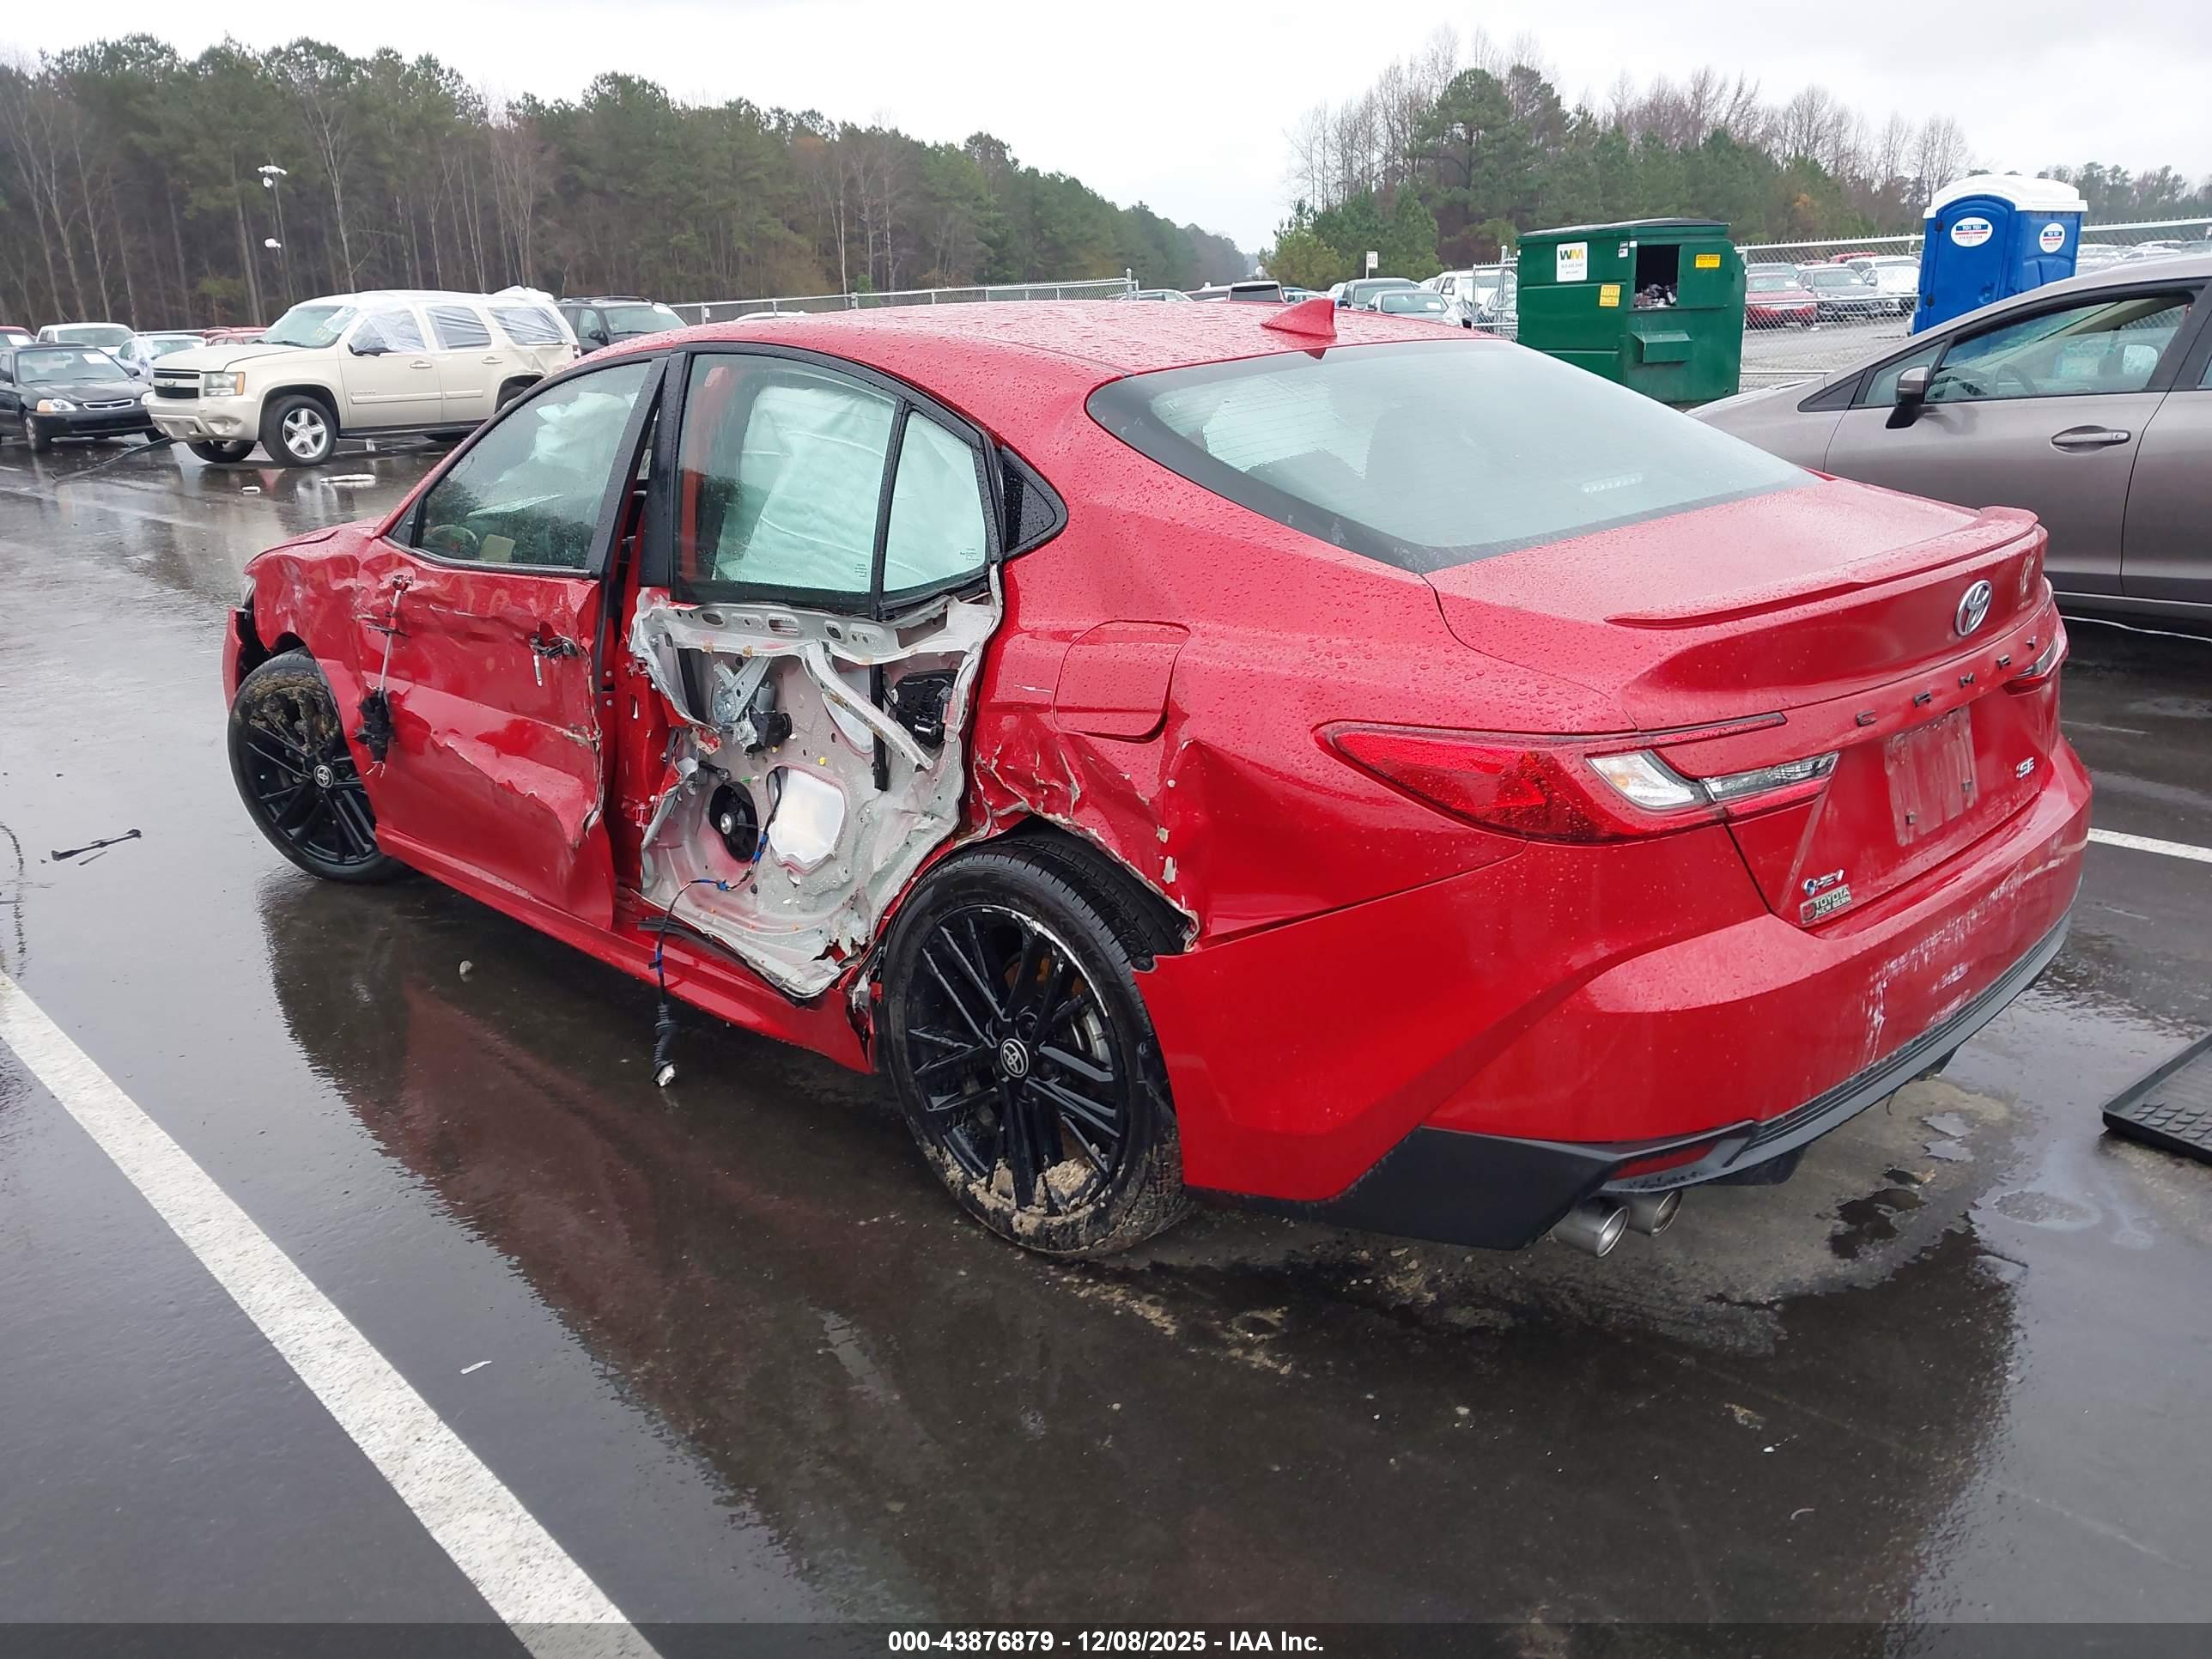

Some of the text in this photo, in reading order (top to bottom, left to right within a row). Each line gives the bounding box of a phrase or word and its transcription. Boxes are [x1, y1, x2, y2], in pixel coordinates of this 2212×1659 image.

[1559, 247, 1584, 260] WM
[1856, 635, 2038, 726] CAMRY
[2015, 757, 2035, 779] SE
[1814, 886, 1850, 908] TOYOTA
[1816, 904, 1832, 915] NEW
